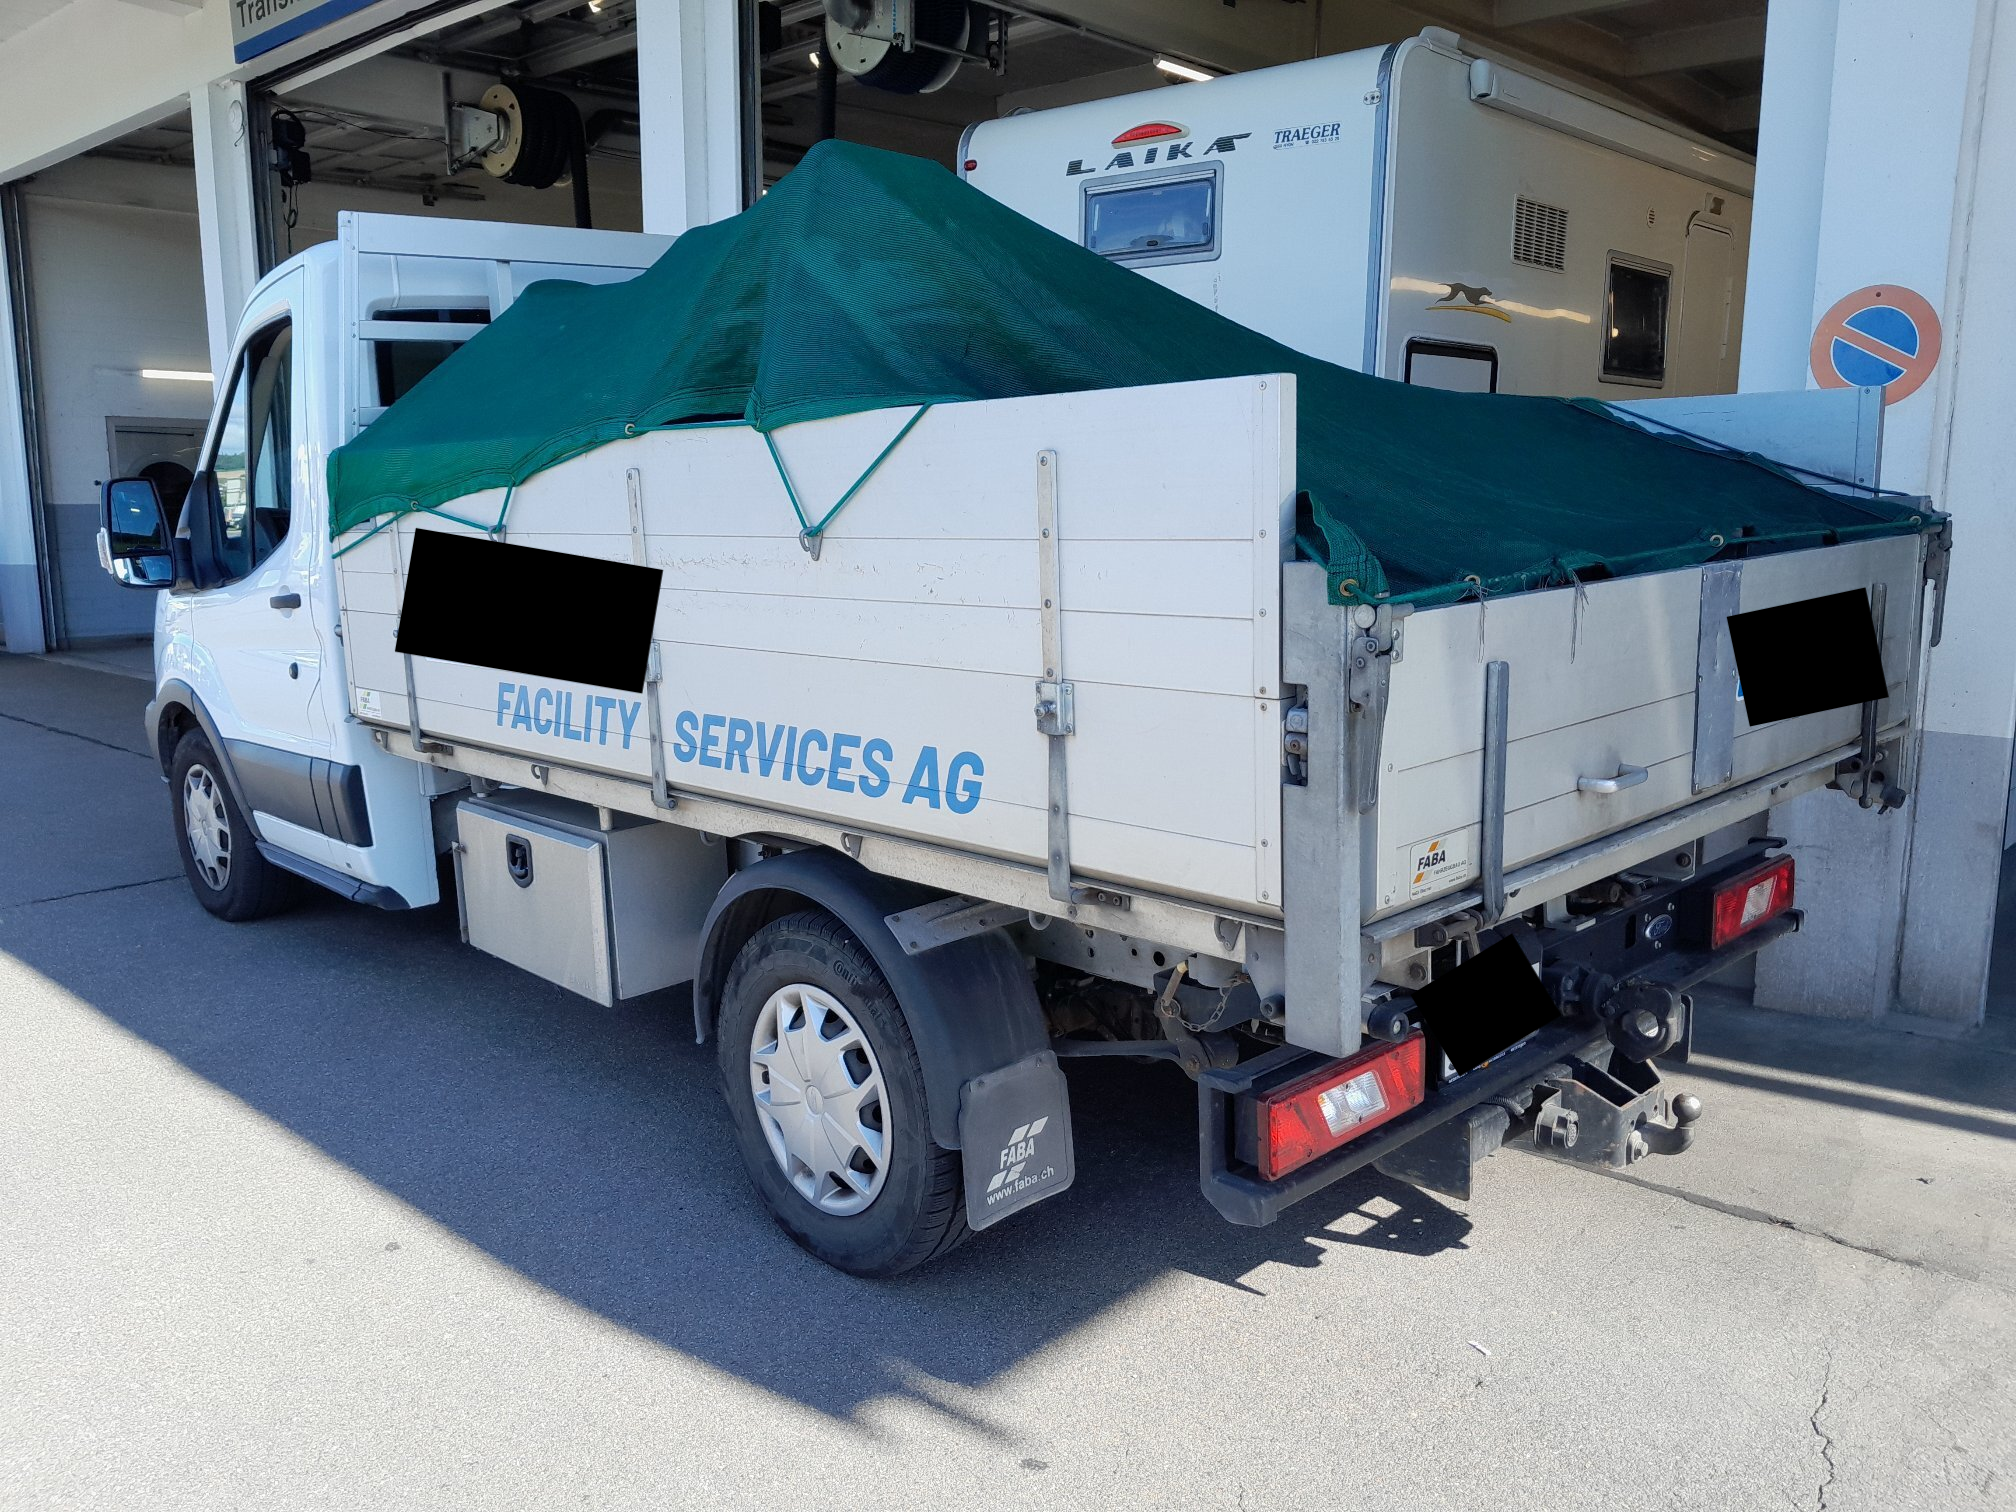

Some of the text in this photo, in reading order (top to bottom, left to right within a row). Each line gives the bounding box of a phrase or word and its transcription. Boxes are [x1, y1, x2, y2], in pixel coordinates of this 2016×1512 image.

[1274, 123, 1341, 144] TRAEGER
[1066, 132, 1252, 176] LAIKA
[496, 682, 985, 815] FACILITY SERVICES AG
[1417, 849, 1446, 871] FABA
[1000, 1138, 1035, 1169] FABA
[986, 1166, 1055, 1206] www.faba.ch
